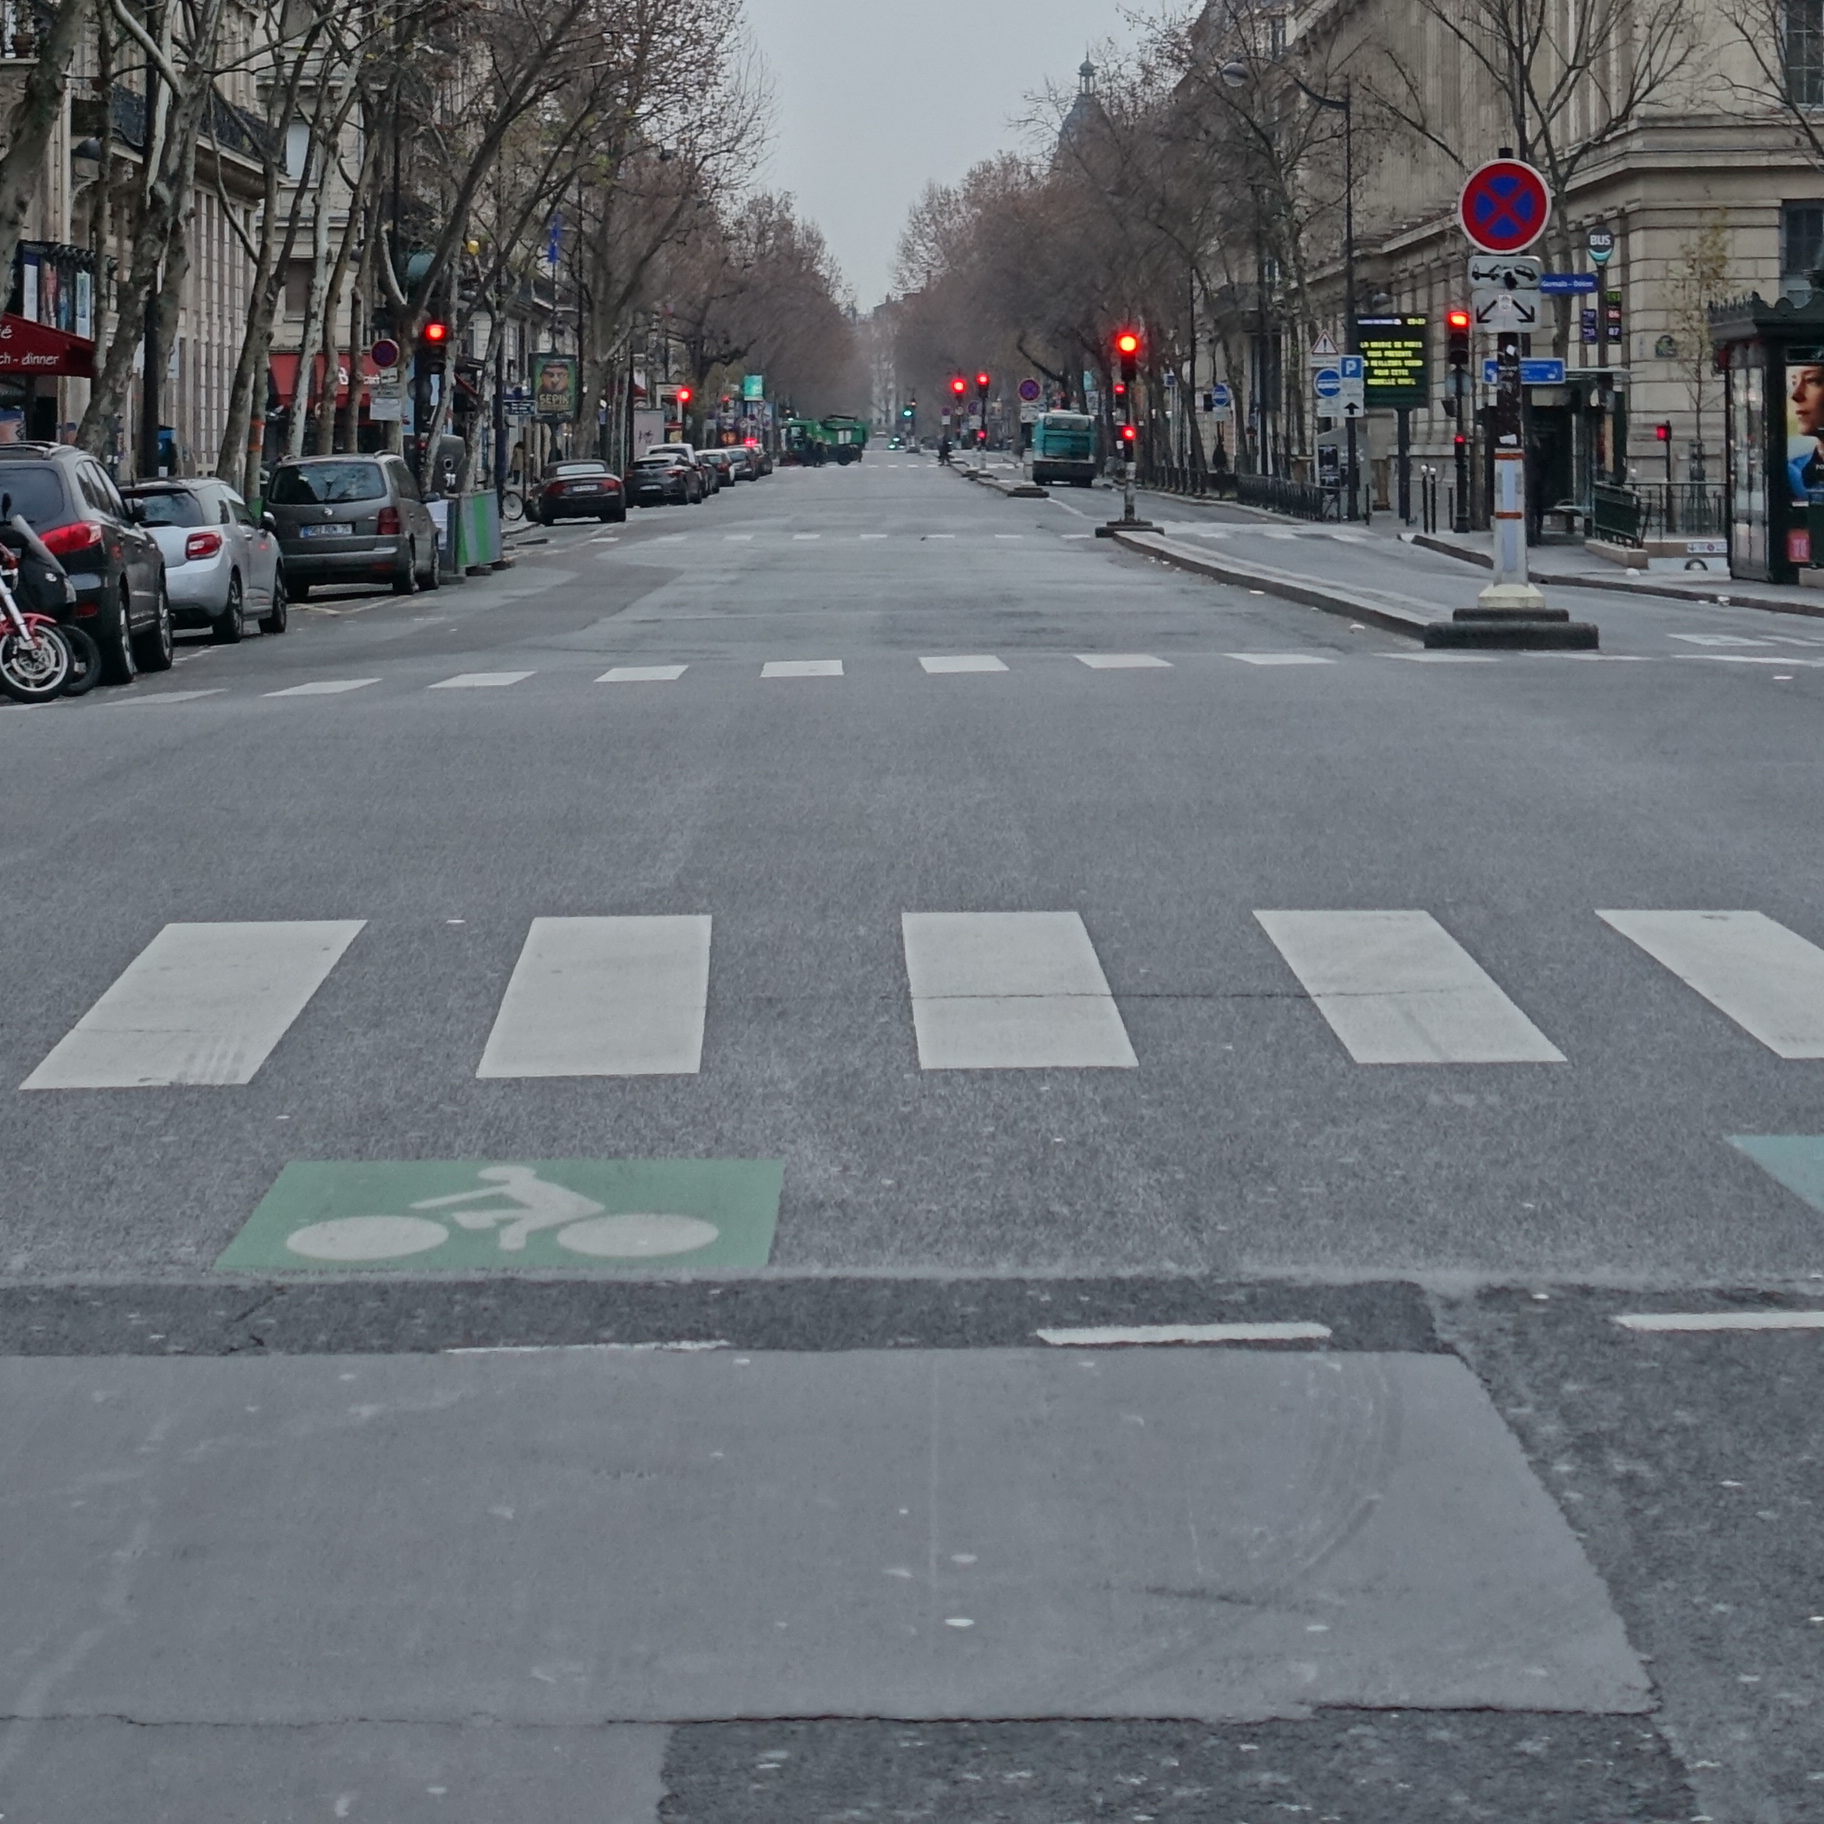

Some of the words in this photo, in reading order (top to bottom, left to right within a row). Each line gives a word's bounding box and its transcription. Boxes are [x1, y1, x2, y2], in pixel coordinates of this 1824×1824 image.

[1590, 235, 1611, 246] BUS
[21, 350, 60, 366] dinner
[1346, 360, 1357, 375] P
